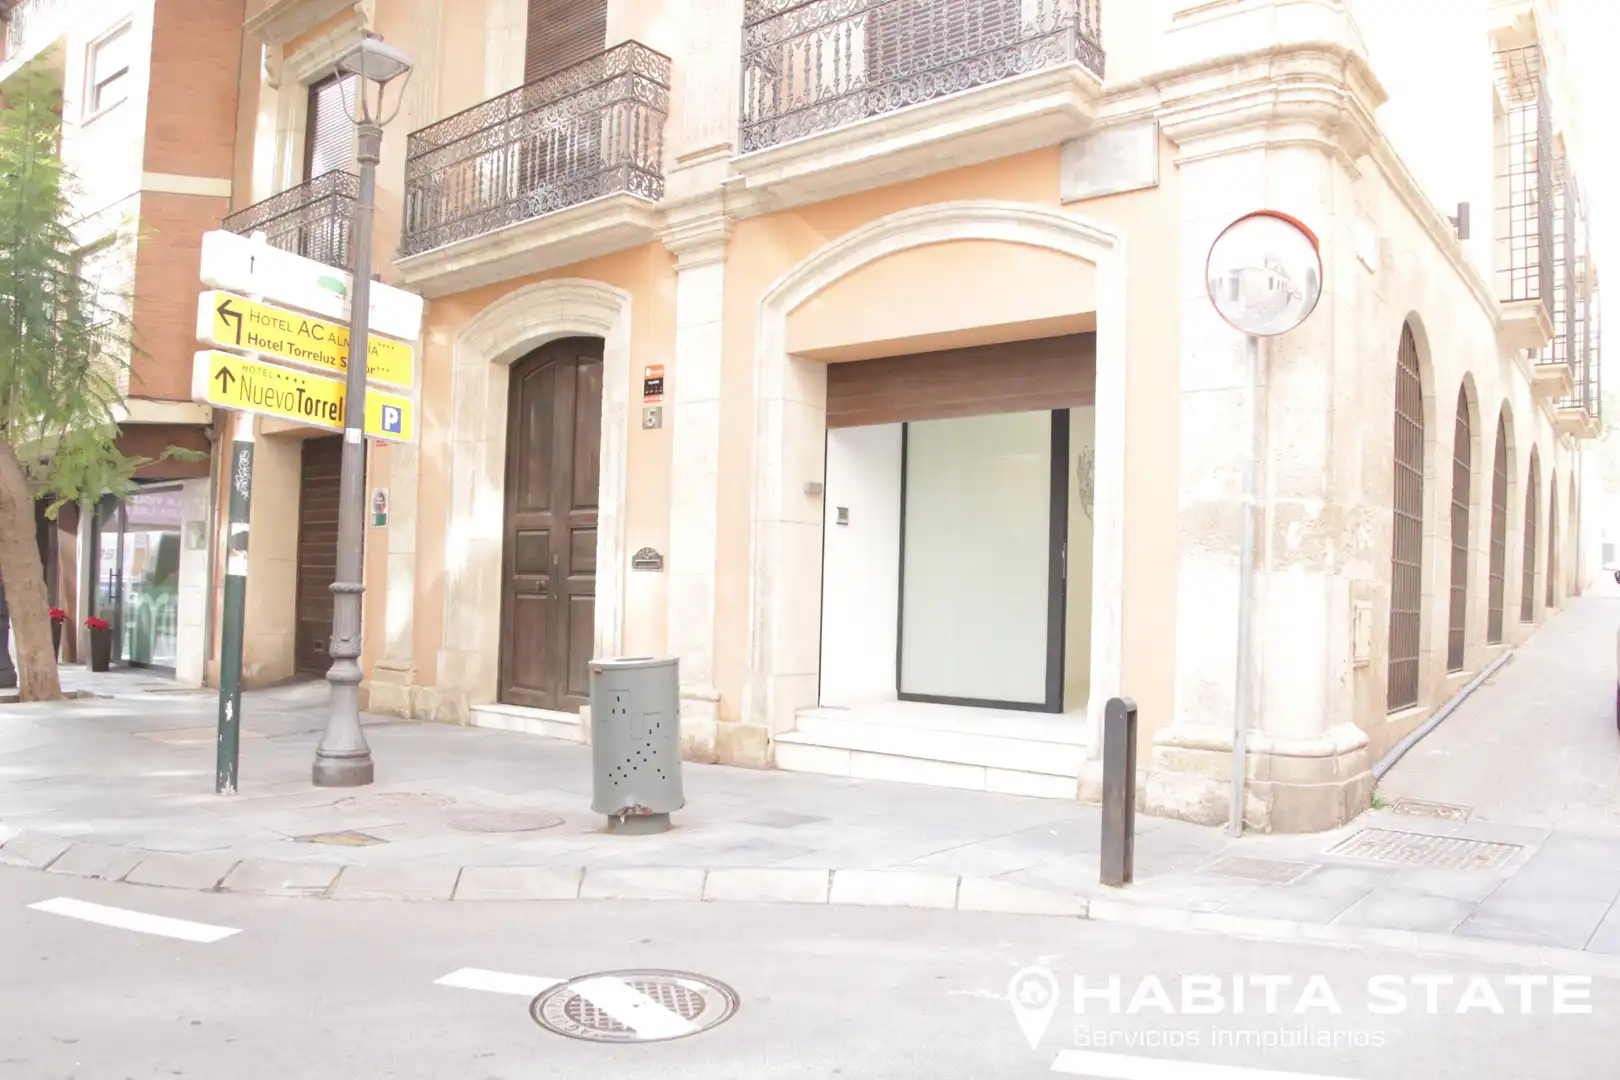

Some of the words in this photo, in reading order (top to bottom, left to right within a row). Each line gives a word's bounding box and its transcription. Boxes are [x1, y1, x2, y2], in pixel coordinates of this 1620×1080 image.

[250, 309, 293, 333] HOTEL
[297, 320, 325, 341] AC
[327, 332, 379, 357] ALMÍA
[247, 331, 284, 352] Hotel
[287, 342, 337, 366] Torreluz
[242, 363, 273, 379] HOTEL
[383, 406, 399, 430] P
